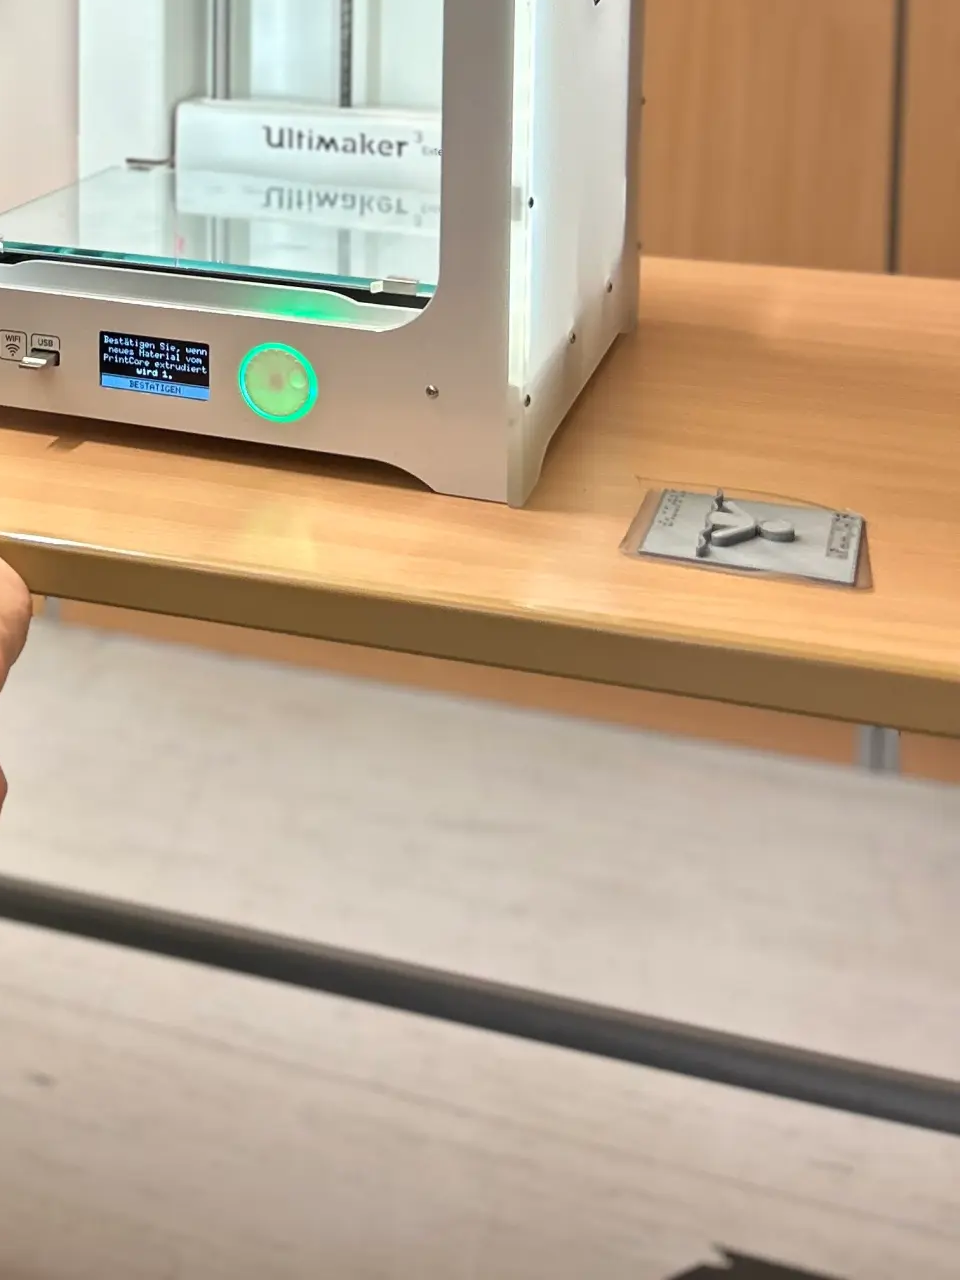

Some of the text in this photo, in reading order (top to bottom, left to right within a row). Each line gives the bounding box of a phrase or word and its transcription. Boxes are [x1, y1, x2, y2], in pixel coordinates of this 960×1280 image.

[262, 125, 408, 158] Ultimaker
[5, 334, 21, 343] WIFI
[37, 338, 53, 347] USB
[103, 334, 208, 356] Bestätigen Sie, wenn
[103, 353, 208, 374] PrintCore extrudiert
[108, 346, 202, 364] neues Material vom
[136, 367, 173, 379] wird 1.
